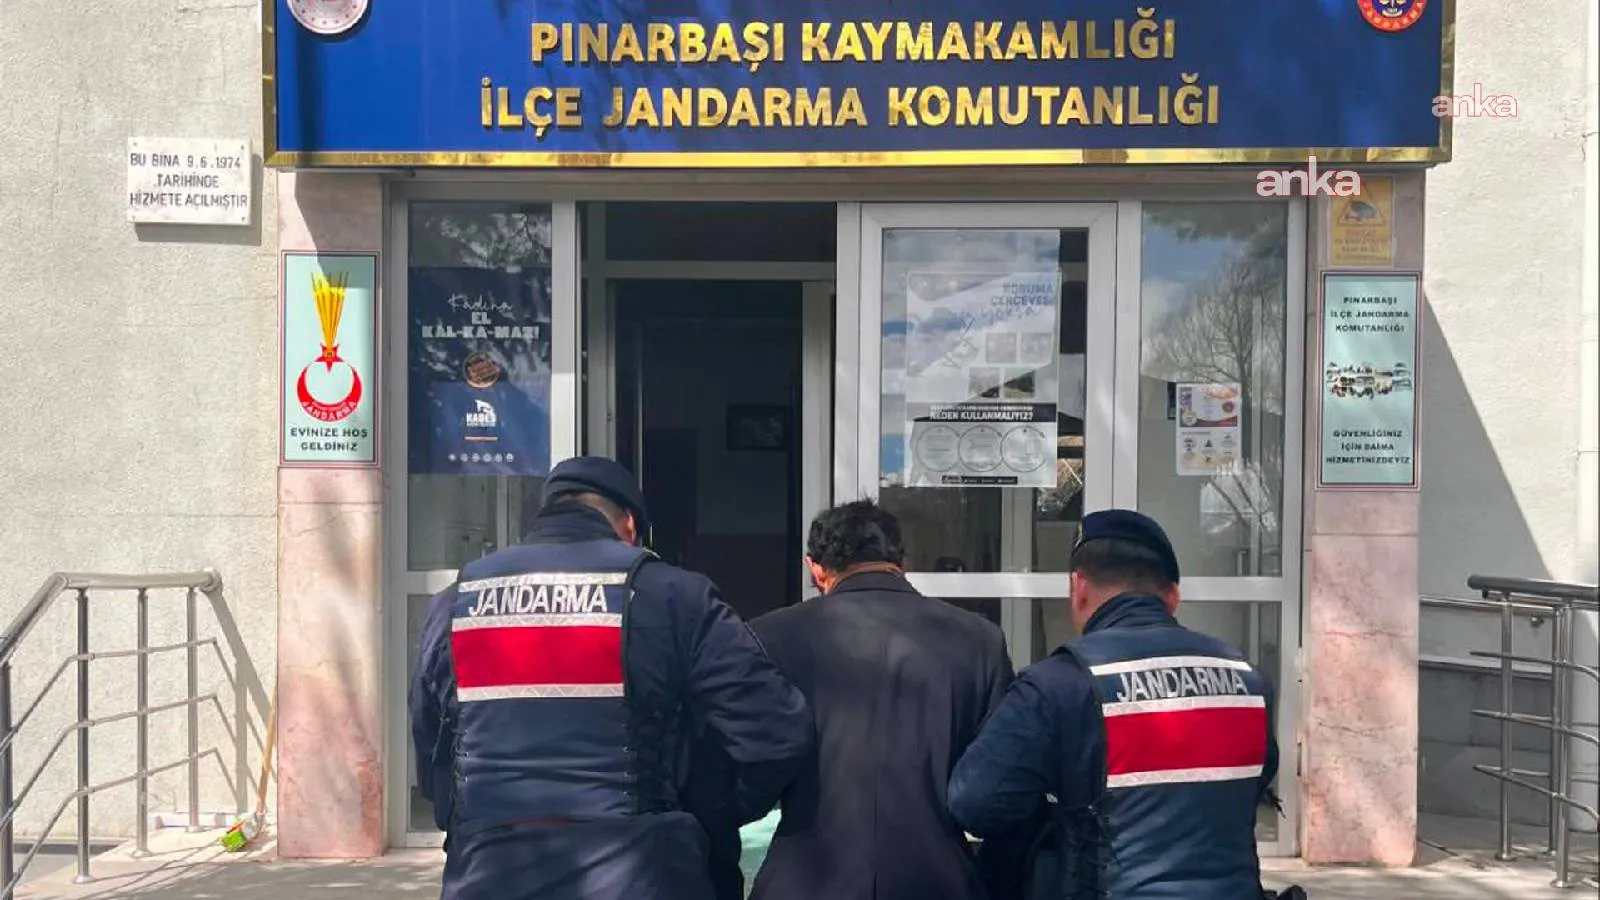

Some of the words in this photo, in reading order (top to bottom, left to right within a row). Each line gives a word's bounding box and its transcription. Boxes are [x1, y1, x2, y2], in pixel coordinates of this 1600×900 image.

[531, 22, 785, 72] PINARBAŞI
[801, 7, 1176, 62] KAYMAKAMLIĞI
[480, 76, 583, 140] İLÇE
[603, 86, 868, 128] JANDARMA
[888, 72, 1220, 128] KOMUTANLIĞI
[130, 153, 146, 166] BU
[157, 172, 220, 188] TARİHİNDE
[129, 190, 182, 207] HİZMETE
[184, 193, 248, 211] AÇILMIŞTIR
[1343, 296, 1398, 305] PINARBAŞI
[472, 311, 492, 325] EL
[1330, 309, 1353, 319] İLÇE
[1335, 323, 1405, 333] KOMUTANLIĞI
[300, 401, 358, 421] JANDARMA
[290, 427, 339, 437] EVİNİZE
[300, 441, 358, 452] GELDİNİZ
[468, 584, 608, 616] JANDARMA
[1116, 667, 1249, 702] JANDARMA
